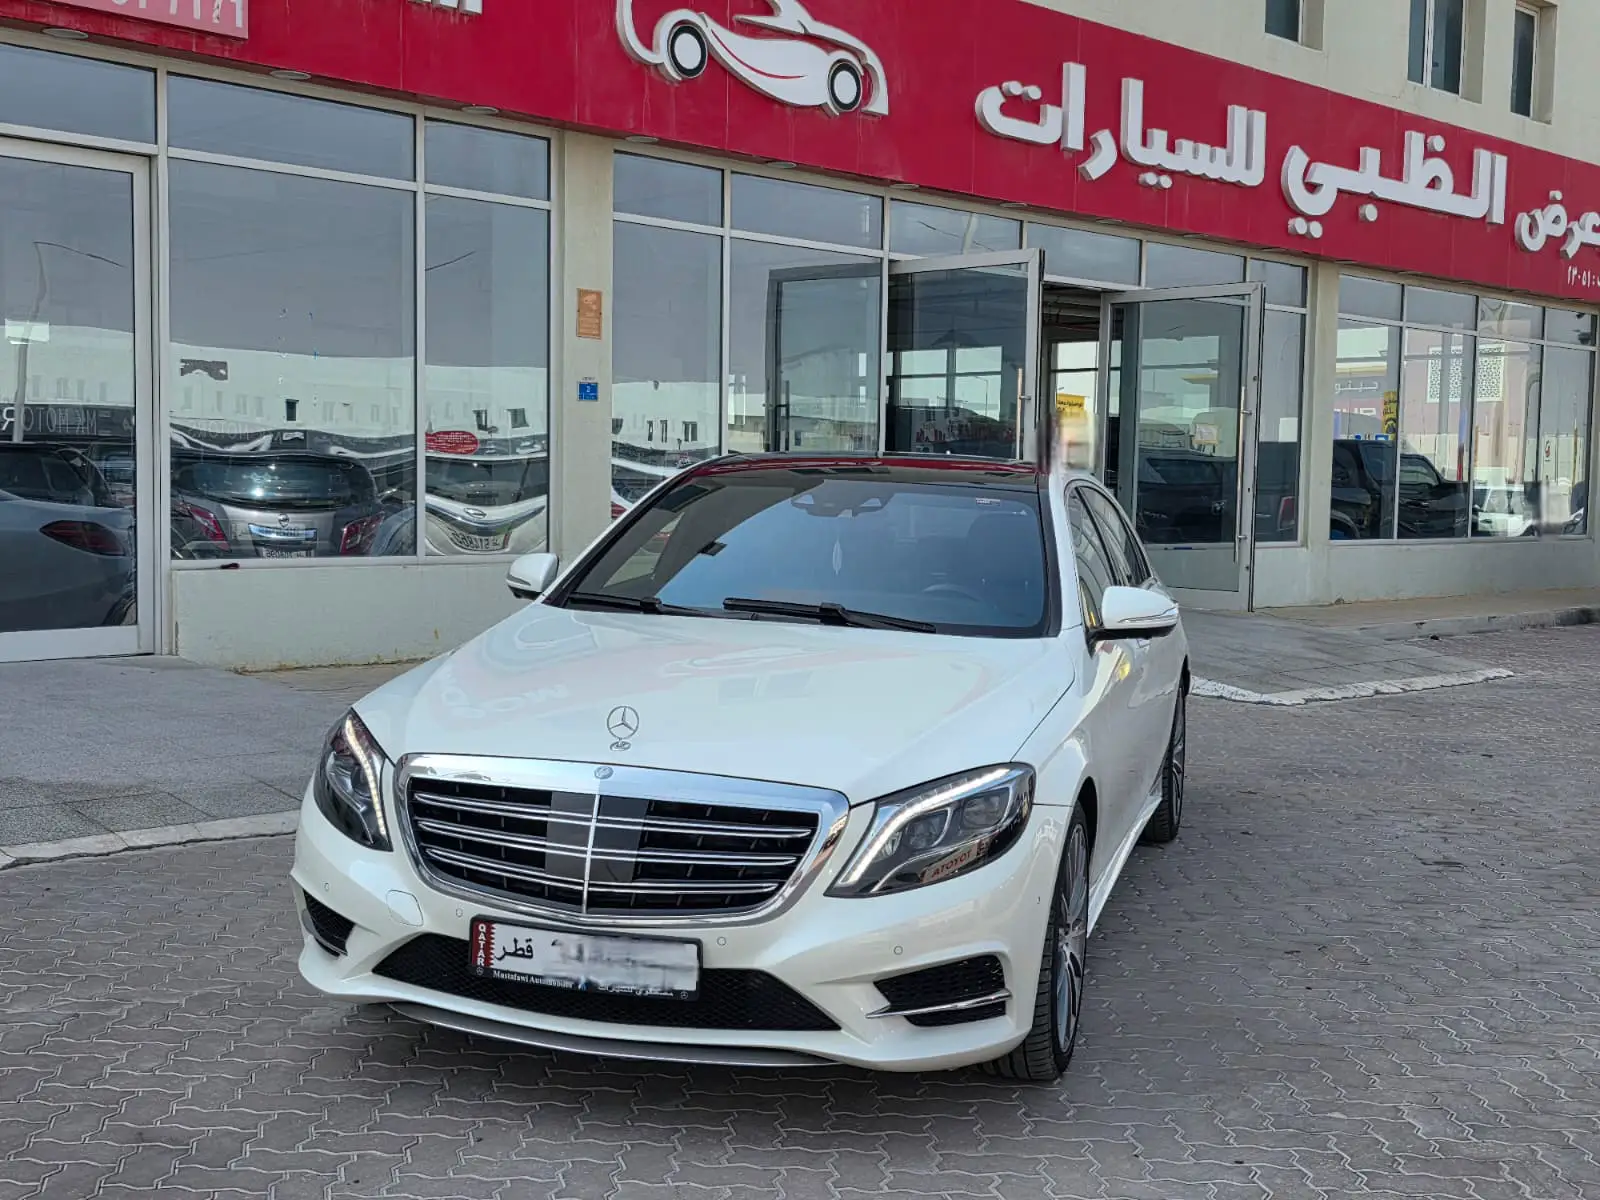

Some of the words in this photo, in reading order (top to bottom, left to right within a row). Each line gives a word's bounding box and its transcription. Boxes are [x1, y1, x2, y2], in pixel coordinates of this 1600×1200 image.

[975, 61, 1267, 189] للسيارات
[1281, 130, 1508, 239] الظبي
[1514, 190, 1600, 259] عرض
[477, 923, 487, 967] QATAR
[494, 936, 534, 961] قطر
